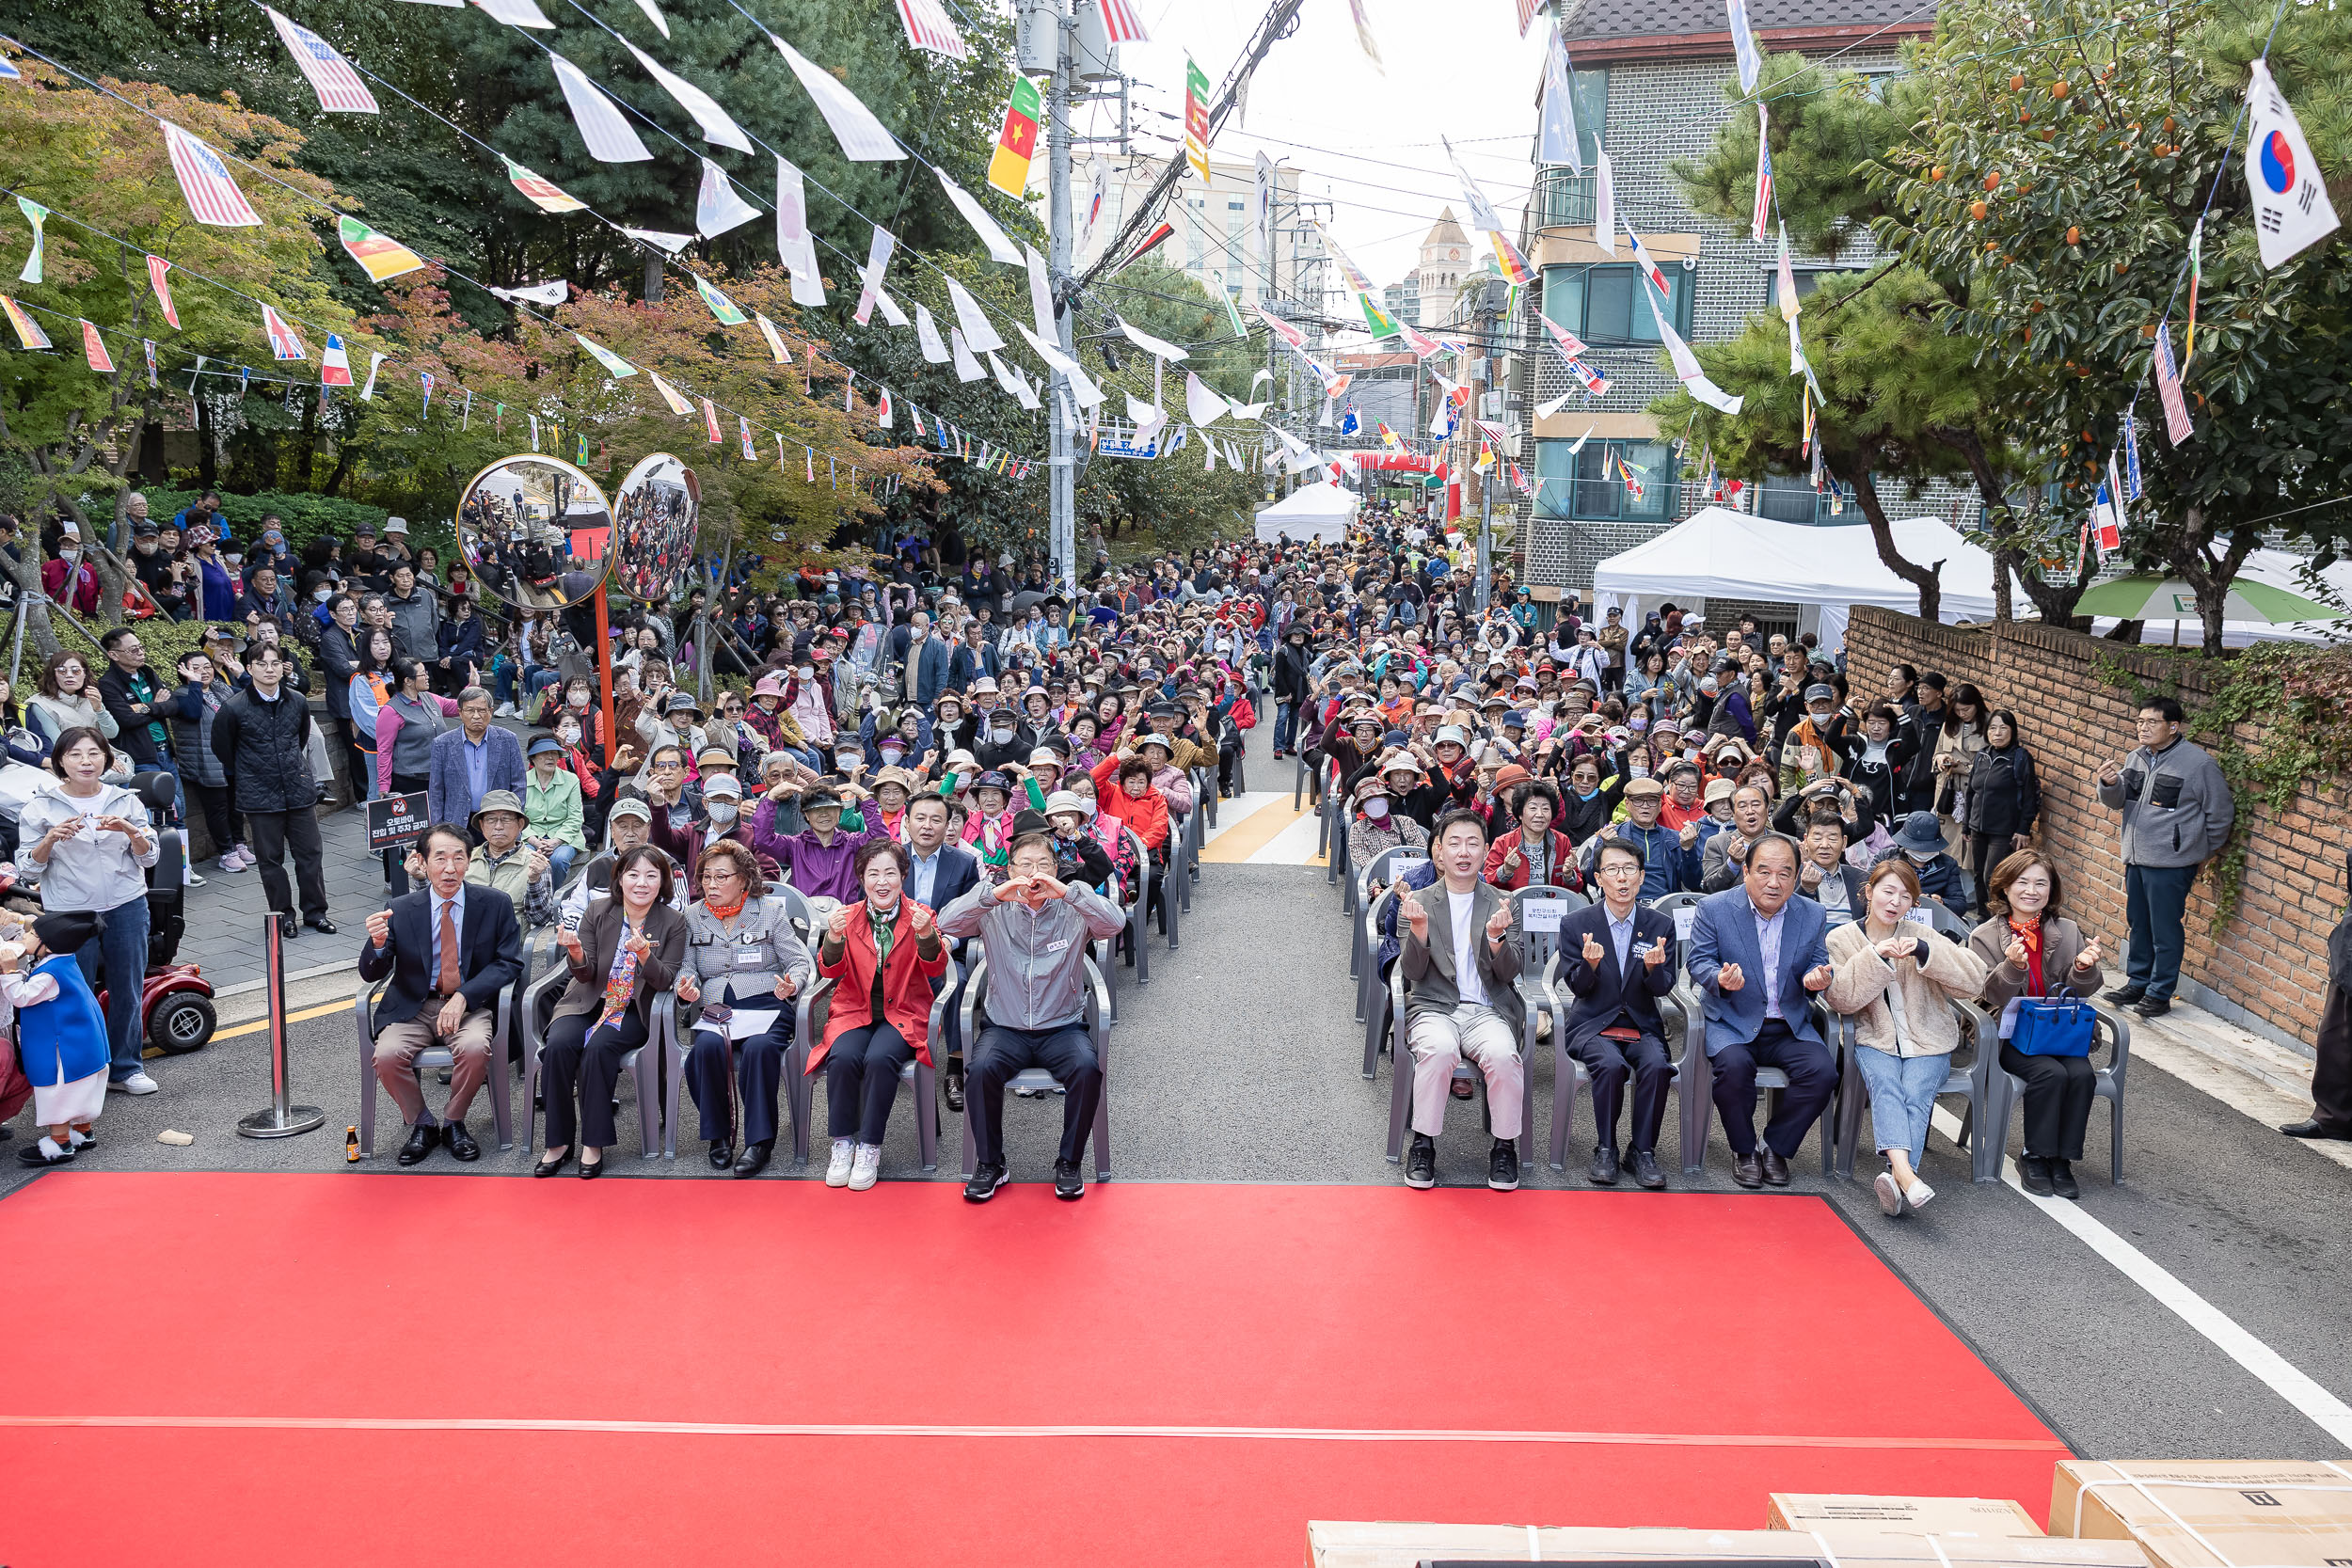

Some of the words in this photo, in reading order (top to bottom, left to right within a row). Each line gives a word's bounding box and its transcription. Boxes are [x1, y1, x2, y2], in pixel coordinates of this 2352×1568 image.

[1022, 45, 1031, 55] 75
[387, 815, 414, 827] 오토바이
[372, 829, 387, 838] 진입
[389, 827, 396, 835] 및
[397, 824, 411, 833] 주차
[413, 820, 428, 831] 금지!
